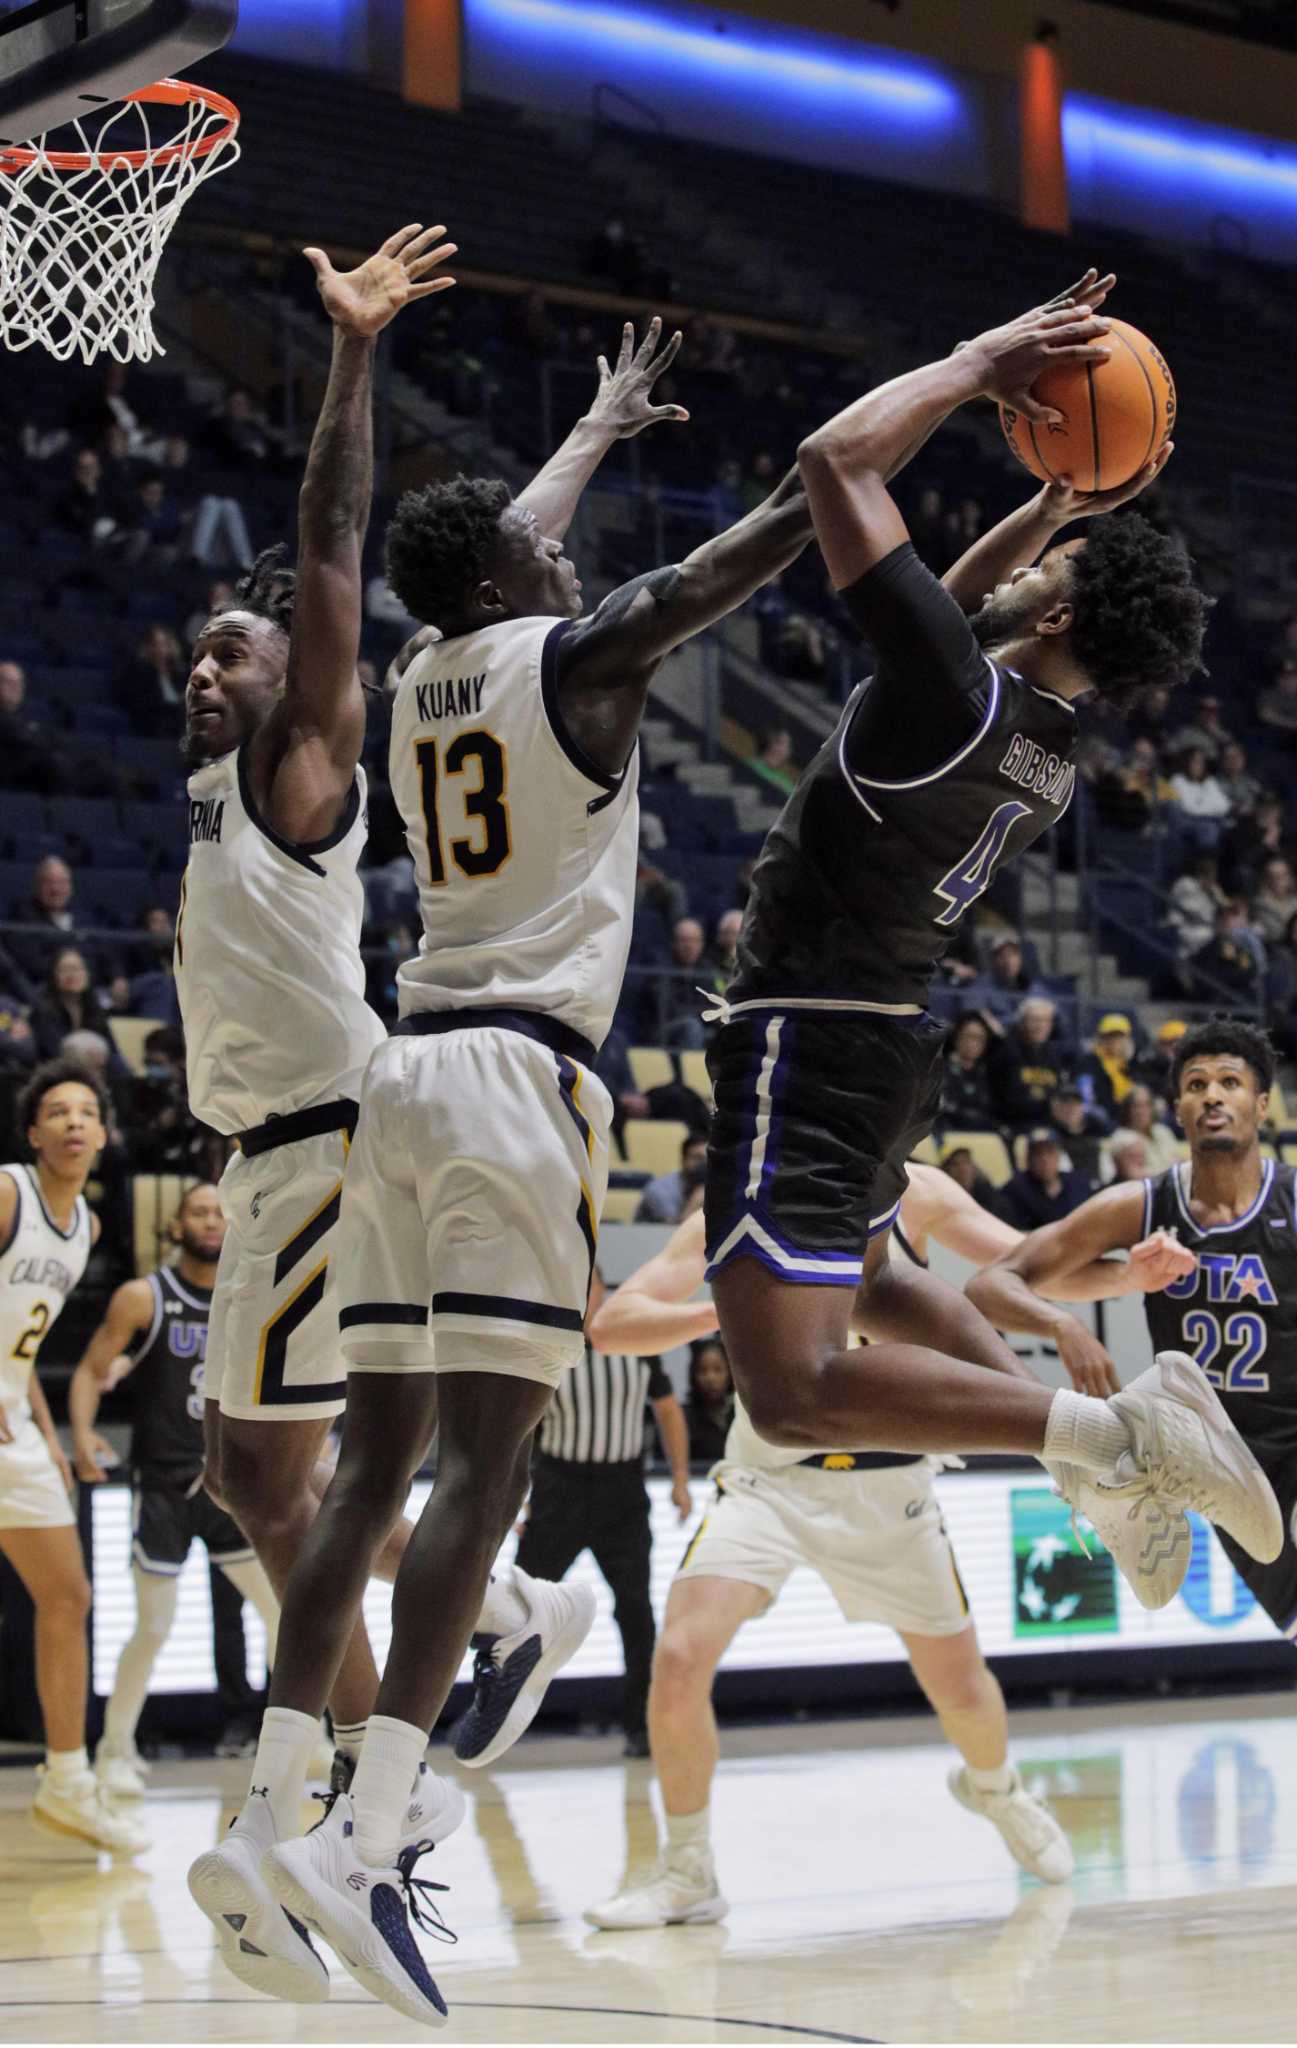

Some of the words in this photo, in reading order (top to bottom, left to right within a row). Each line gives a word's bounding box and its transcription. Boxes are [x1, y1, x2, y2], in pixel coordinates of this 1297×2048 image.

[416, 673, 486, 722] KUANY
[999, 733, 1076, 805] GIBSON
[413, 725, 512, 887] 13
[933, 800, 1034, 926] 4
[12, 1301, 50, 1359] 2
[168, 1319, 208, 1359] UT
[1182, 1309, 1270, 1393] 22
